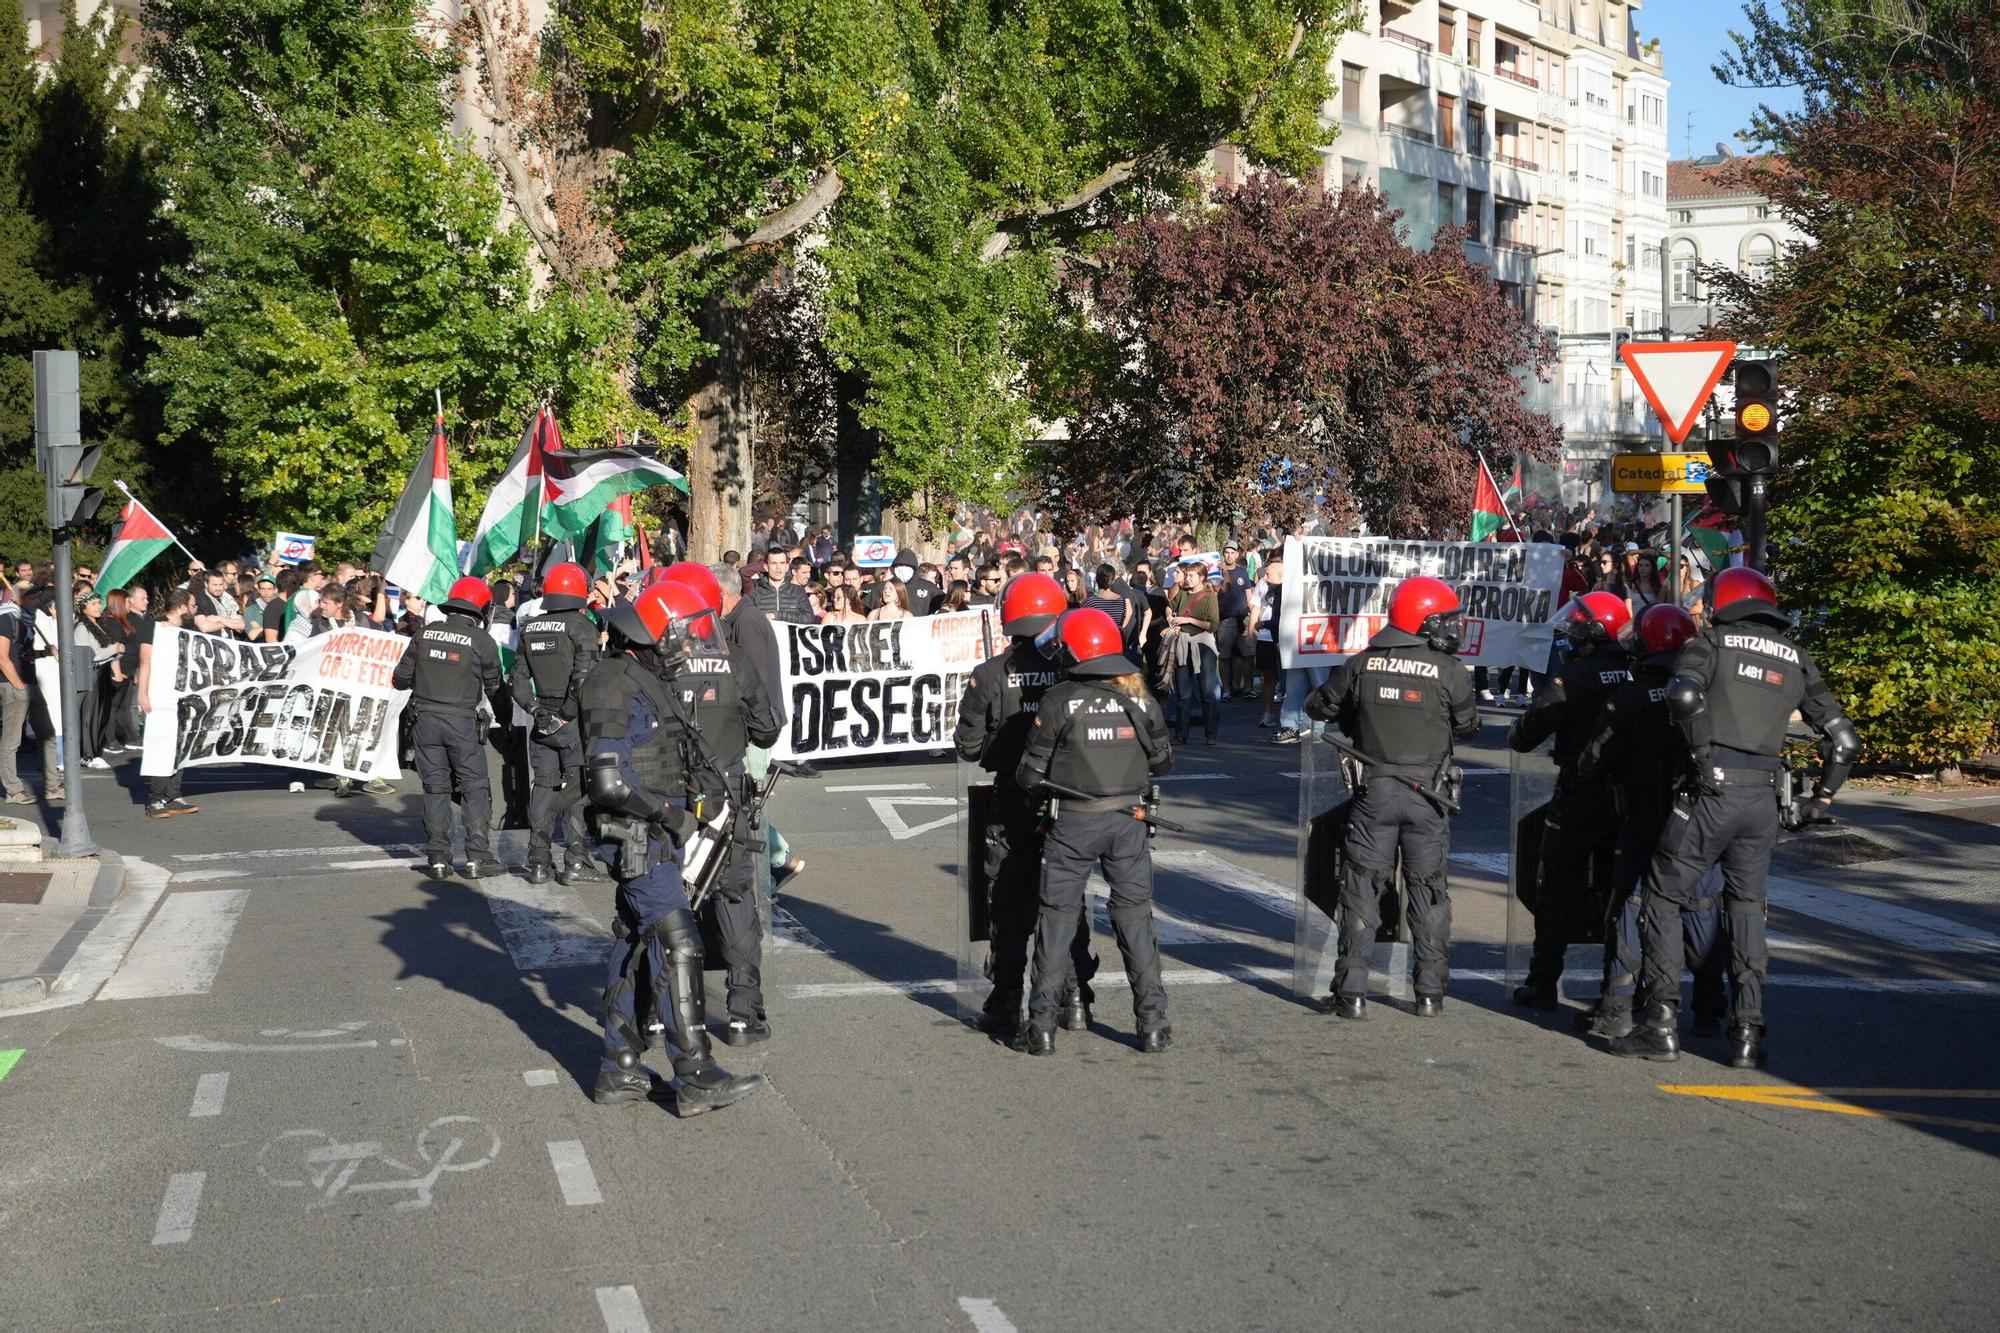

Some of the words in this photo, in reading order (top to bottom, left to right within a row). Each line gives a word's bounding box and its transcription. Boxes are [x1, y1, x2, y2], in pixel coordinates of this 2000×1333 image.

[1618, 467, 1681, 480] Catedral
[1302, 542, 1527, 583] KOLONIZAZIOAREN
[1449, 583, 1552, 623] ORROKA
[423, 629, 472, 647] ERTZAINTZA
[525, 621, 566, 633] ERTZAINTZA
[1301, 617, 1329, 651] EZ
[1339, 617, 1369, 651] DA
[174, 630, 296, 691] ISRAEL
[788, 620, 914, 676] ISRAEL
[1724, 634, 1800, 664] ERTZAINTZA
[686, 658, 731, 674] AINTZA
[1648, 687, 1667, 702] ER
[174, 684, 389, 774] DESEGIN!
[1088, 727, 1114, 741] N1V1
